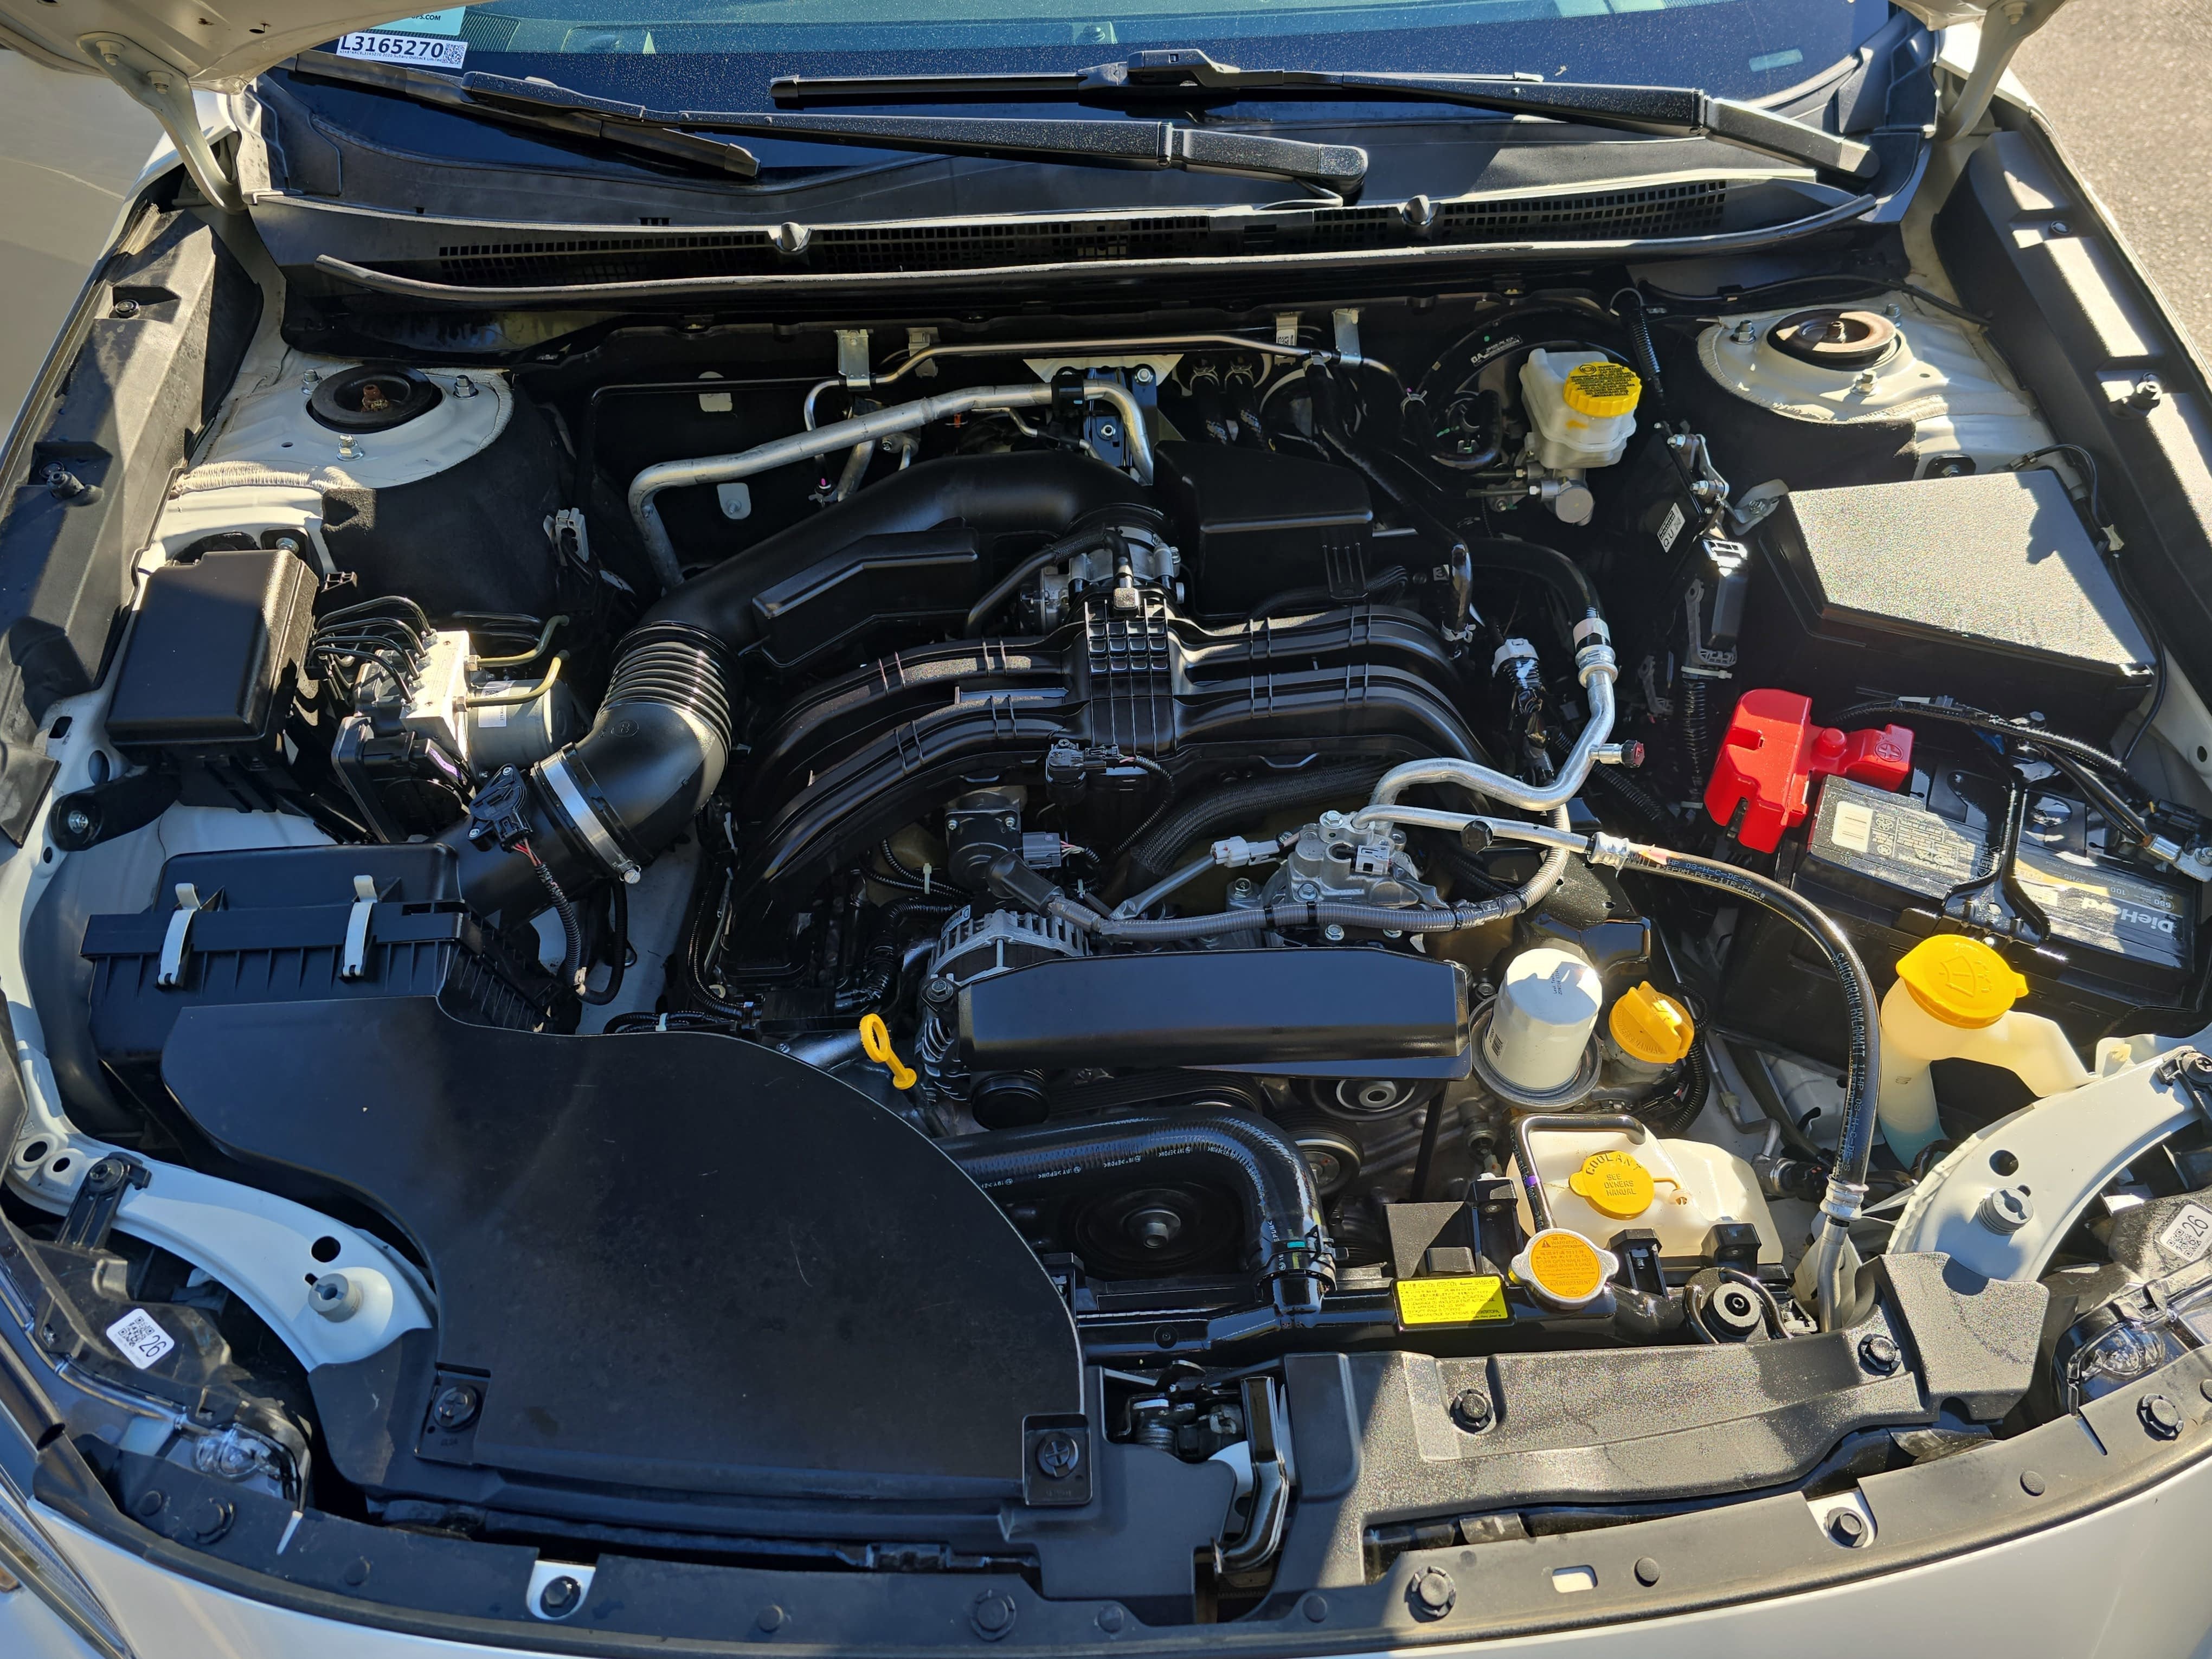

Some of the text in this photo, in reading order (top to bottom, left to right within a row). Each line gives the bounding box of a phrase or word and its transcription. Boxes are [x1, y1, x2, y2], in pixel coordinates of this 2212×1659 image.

[340, 35, 444, 58] L3165270
[2110, 886, 2126, 896] 100
[2081, 897, 2176, 934] DieHard
[1850, 1006, 1866, 1057] HYLAMMIT
[1634, 1039, 1662, 1054] MANUAL
[1857, 1063, 1866, 1090] 11HP
[1585, 1152, 1642, 1175] COOLANT
[1605, 1188, 1637, 1197] MANUAL
[2182, 1215, 2209, 1237] 26
[138, 1334, 167, 1358] 26
